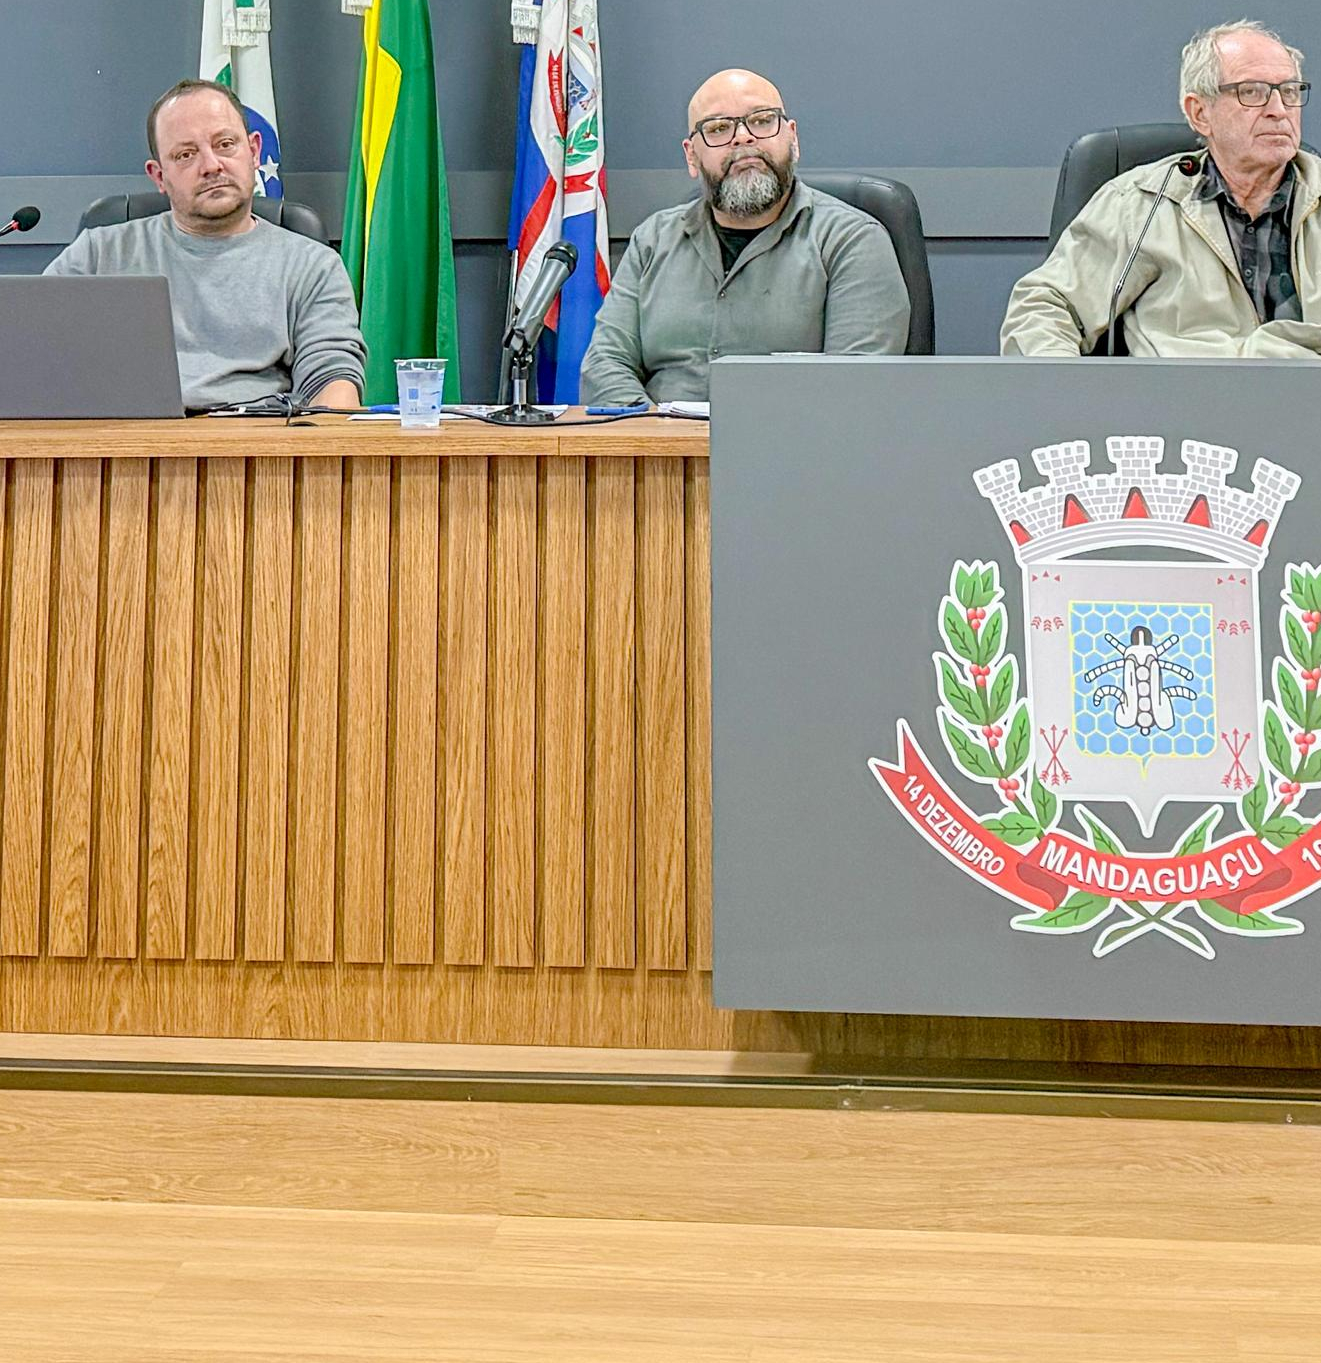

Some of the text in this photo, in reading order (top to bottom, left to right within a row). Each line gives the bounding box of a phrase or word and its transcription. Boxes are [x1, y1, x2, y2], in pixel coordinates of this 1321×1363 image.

[903, 775, 1005, 875] 14 DEZEMBRO
[1038, 839, 1265, 896] MANDAGUAÇU
